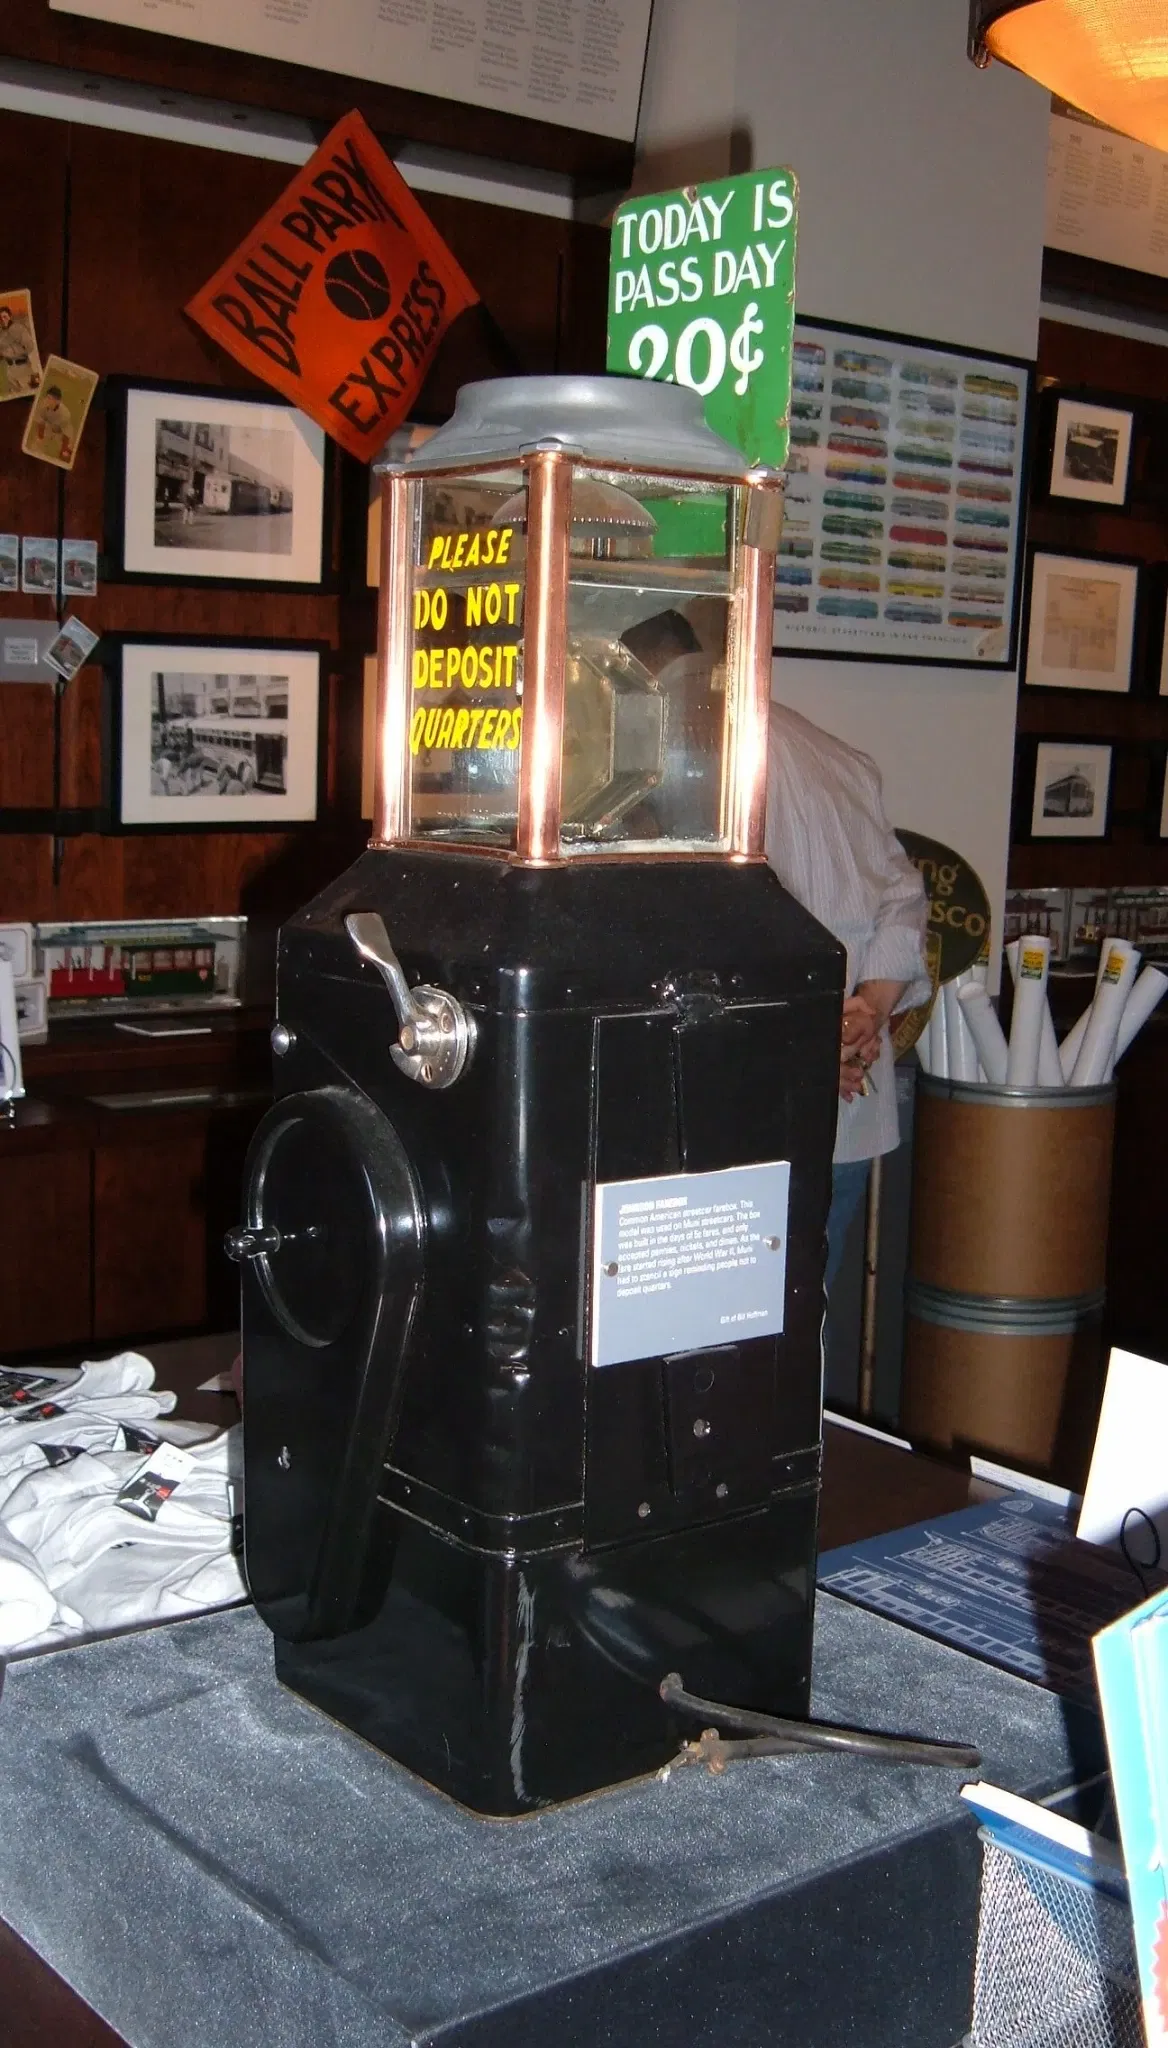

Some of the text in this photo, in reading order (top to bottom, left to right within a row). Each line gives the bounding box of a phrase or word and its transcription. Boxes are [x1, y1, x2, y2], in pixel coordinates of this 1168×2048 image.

[616, 180, 794, 258] TODAY IS
[211, 243, 314, 377] BALL
[281, 138, 409, 254] PARK
[615, 239, 786, 314] PASS DAY
[328, 260, 446, 433] EXPRESS
[628, 302, 764, 397] 20¢
[428, 529, 513, 570] PLEASE
[413, 582, 520, 631] DO NOT
[413, 646, 518, 689] DEPOSIT
[410, 706, 522, 756] QUARTERS
[911, 858, 961, 897] ng
[619, 1215, 649, 1226] Common
[650, 1211, 682, 1222] American
[740, 1200, 754, 1208] This
[619, 1226, 640, 1238] model
[656, 1222, 672, 1233] used
[682, 1217, 700, 1229] Muni
[736, 1211, 748, 1221] The
[669, 1232, 686, 1243] days
[722, 1224, 735, 1235] and
[735, 1222, 749, 1233] only
[658, 1258, 676, 1269] rising
[676, 1254, 692, 1265] after
[694, 1250, 714, 1262] World
[714, 1248, 729, 1258] War
[736, 1244, 754, 1255] Muni
[705, 1238, 718, 1249] and
[750, 1232, 760, 1242] the
[617, 1275, 631, 1286] had
[632, 1274, 639, 1282] to
[668, 1267, 683, 1279] sign
[716, 1258, 738, 1272] people
[750, 1256, 757, 1264] to
[617, 1286, 642, 1298] deposit
[720, 1314, 730, 1324] Gift
